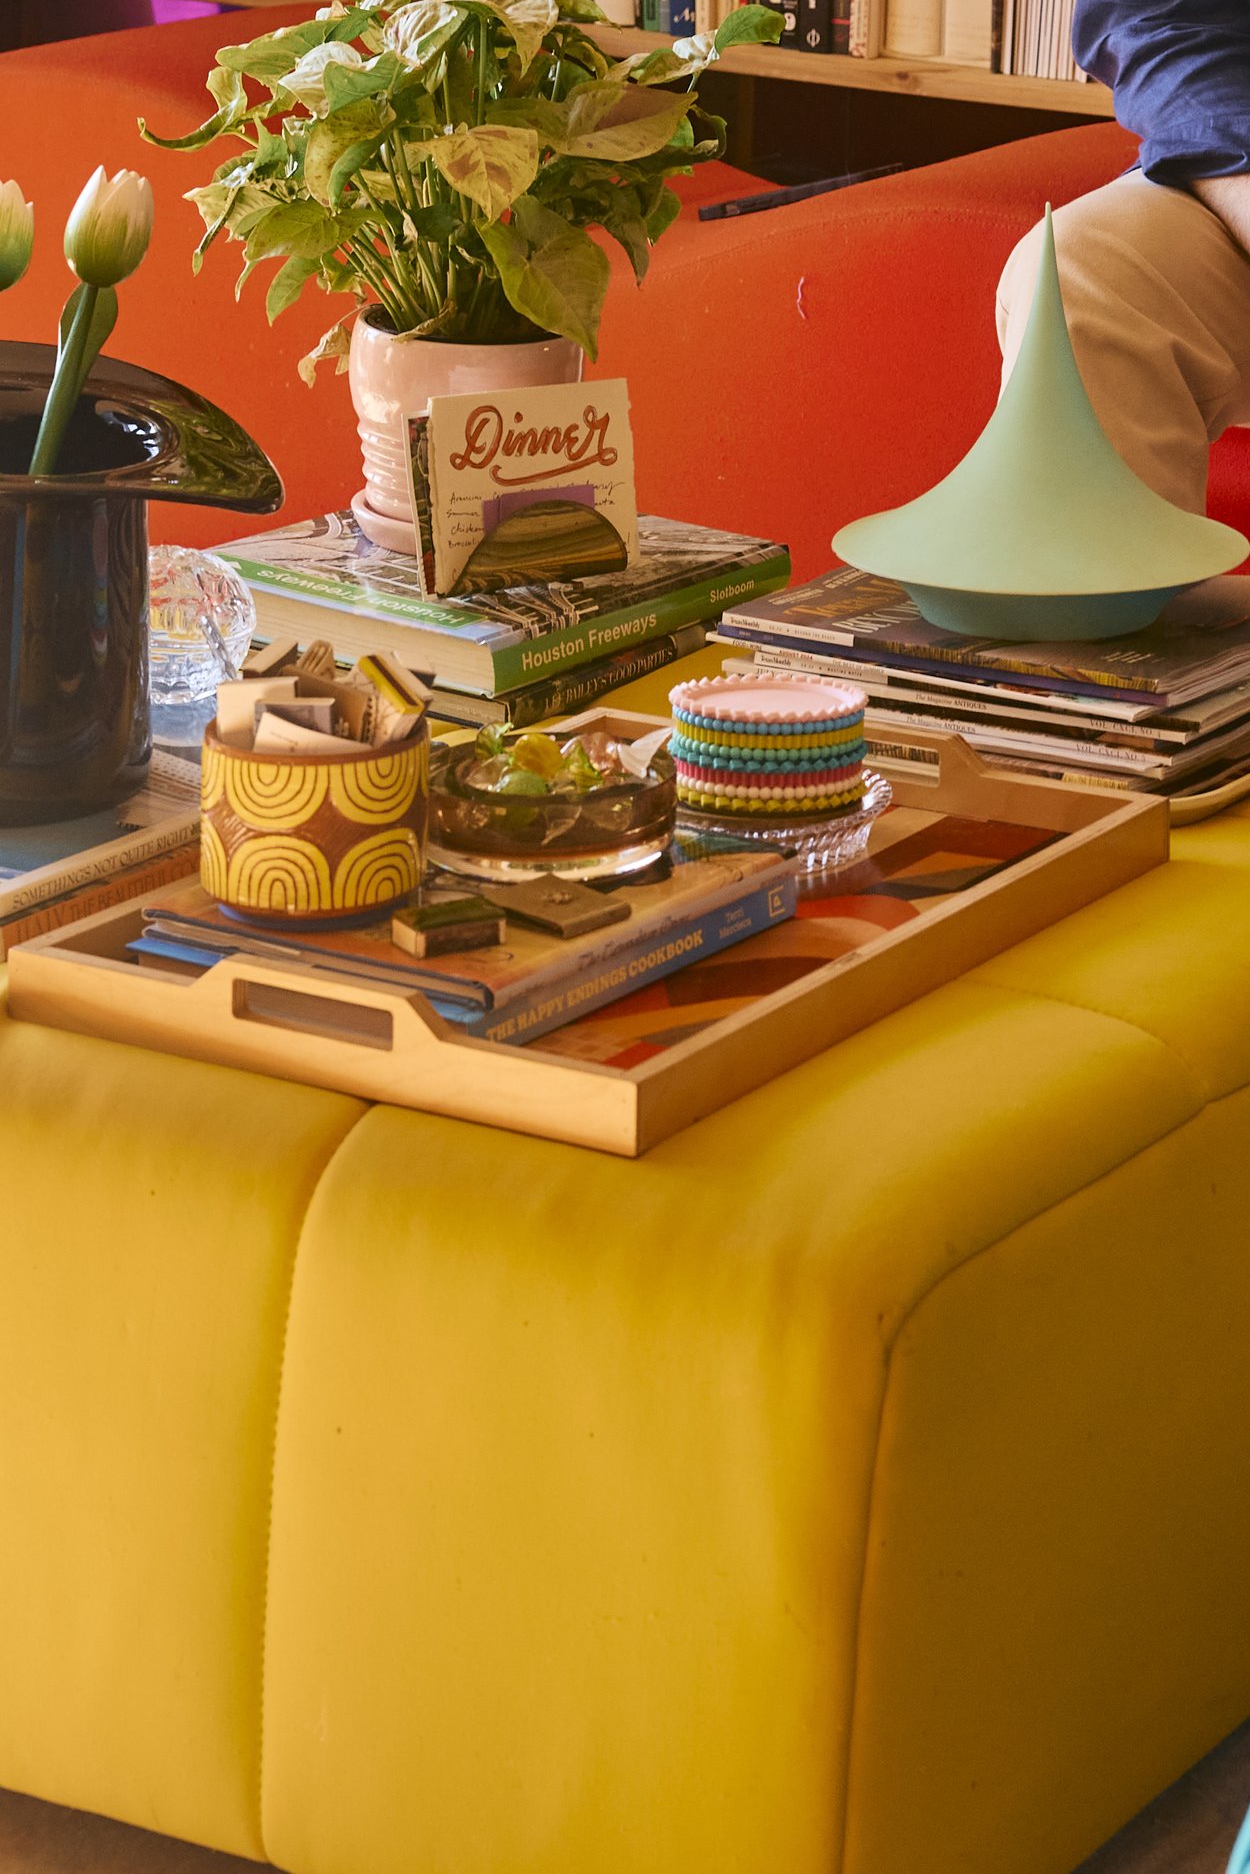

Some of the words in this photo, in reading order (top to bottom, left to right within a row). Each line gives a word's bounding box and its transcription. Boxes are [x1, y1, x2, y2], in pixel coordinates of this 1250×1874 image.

[450, 405, 618, 484] Dinner
[256, 570, 368, 601] Freeways
[709, 578, 755, 604] Slotboom
[369, 595, 466, 625] Houston
[521, 636, 584, 672] Houston
[588, 613, 658, 649] Freeways
[778, 649, 799, 658] AUGUST
[800, 652, 813, 661] 2024
[609, 663, 637, 685] GOOD
[637, 646, 673, 673] PARTIES
[914, 693, 925, 702] The
[926, 694, 953, 706] Magazine
[952, 699, 987, 711] ANTIQUES
[942, 722, 976, 734] ANTIQUES
[92, 854, 118, 877] NOT
[118, 841, 155, 871] QUITE
[156, 828, 192, 850] RIGHT
[487, 1021, 517, 1043] THE
[516, 992, 565, 1029] HAPPY
[566, 967, 628, 1008] ENDINGS
[628, 929, 705, 978] COOKBOOK
